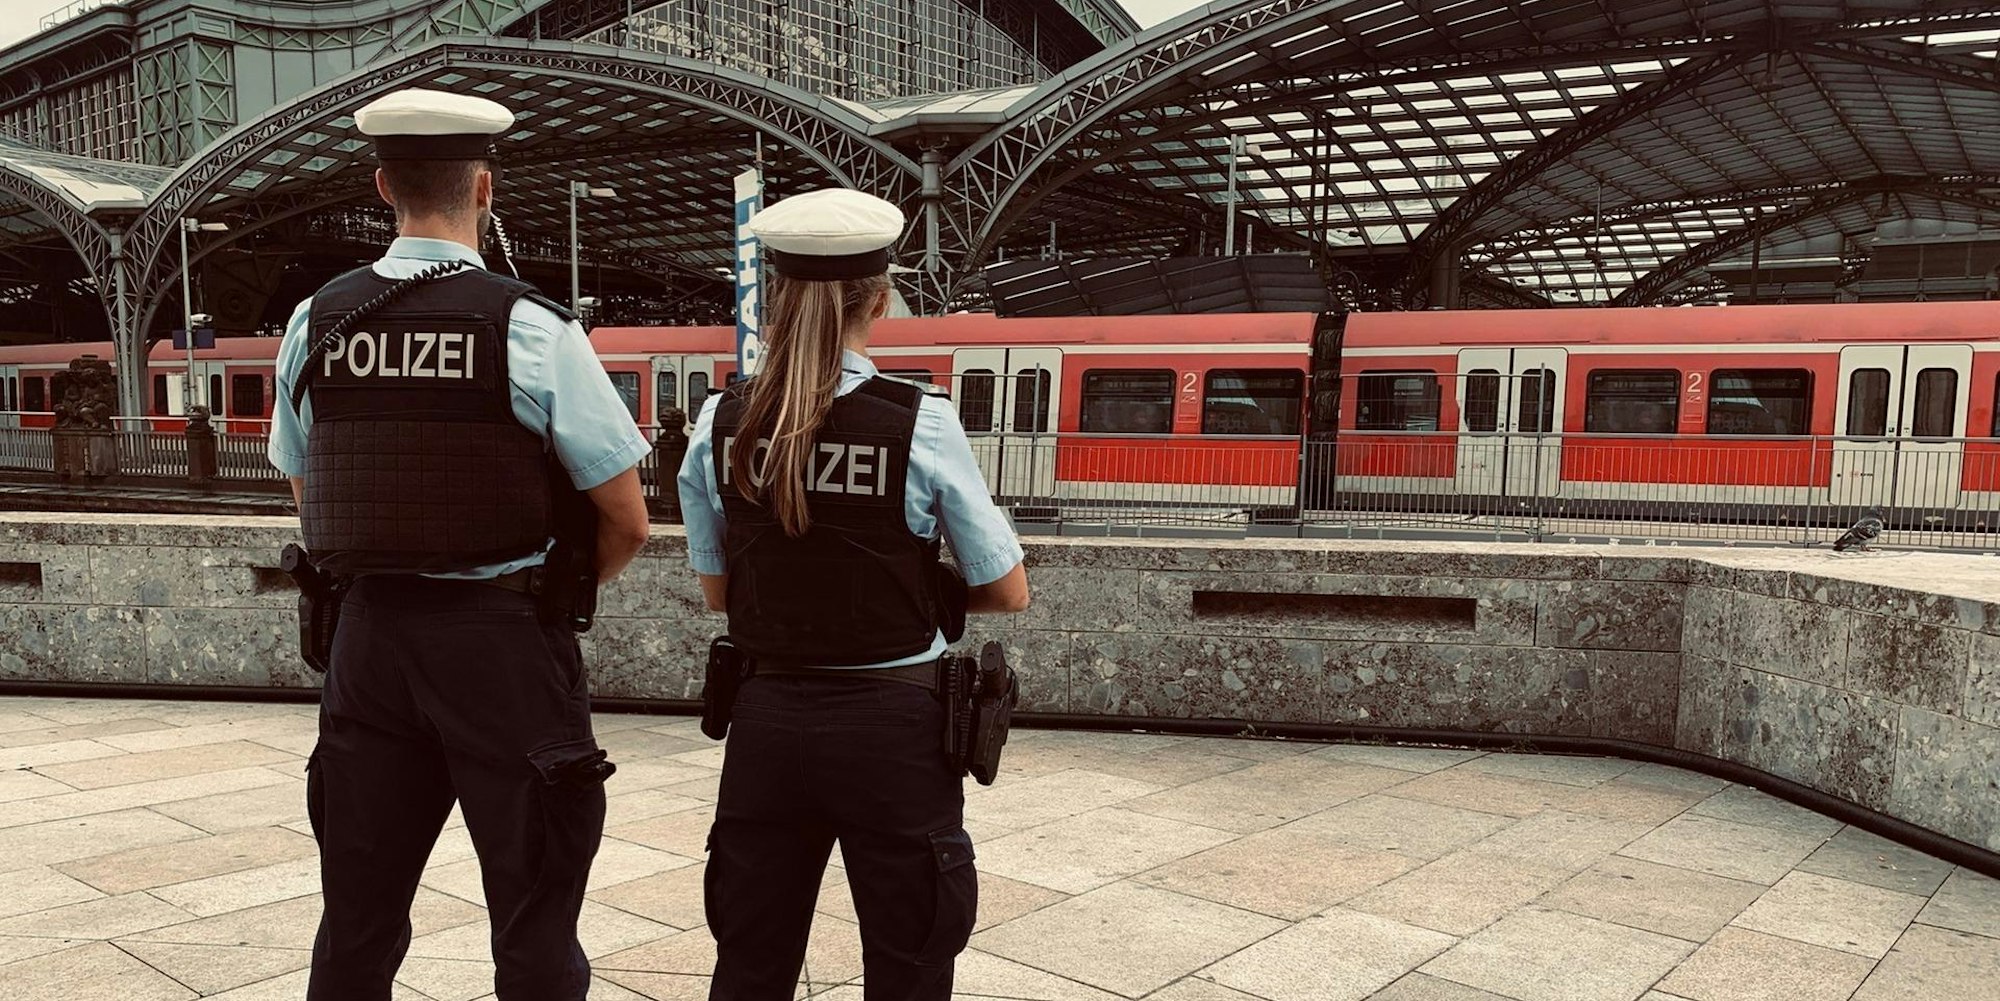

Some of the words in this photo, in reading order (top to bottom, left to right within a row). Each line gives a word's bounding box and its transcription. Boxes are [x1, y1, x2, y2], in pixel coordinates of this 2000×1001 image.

[324, 331, 475, 379] POLIZEI
[1182, 372, 1198, 393] 2
[1687, 372, 1702, 393] 2
[723, 437, 888, 496] POIZEI
